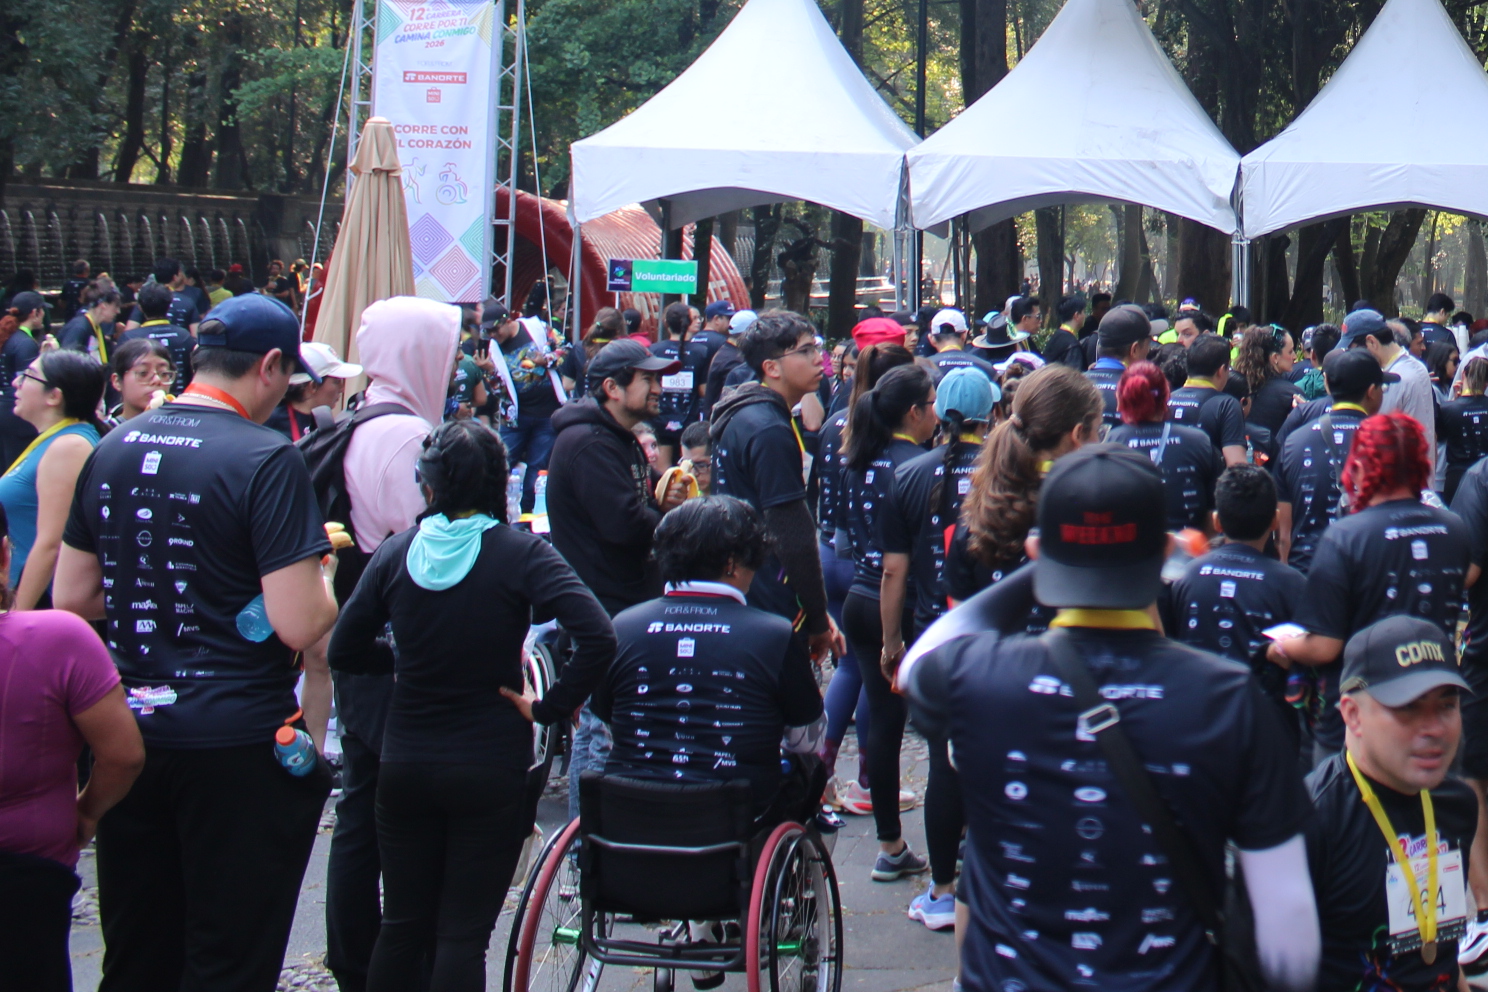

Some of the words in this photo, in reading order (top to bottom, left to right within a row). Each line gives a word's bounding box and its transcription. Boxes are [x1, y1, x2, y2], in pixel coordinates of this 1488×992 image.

[425, 10, 461, 20] CARRERA
[403, 20, 437, 32] CORRE
[437, 18, 457, 29] POR
[459, 17, 468, 26] TI
[394, 31, 431, 44] CAMINA
[432, 26, 476, 39] CONMIGO
[425, 39, 445, 48] 2026
[418, 74, 465, 82] BANORTE
[394, 124, 437, 135] CORRE
[441, 125, 468, 135] CON
[396, 139, 405, 148] L
[408, 138, 471, 149] CORAZÓN
[635, 271, 696, 283] Voluntariado
[669, 378, 686, 387] 983
[138, 433, 204, 448] BANORTE
[1139, 437, 1182, 447] BANTE
[1212, 567, 1265, 581] BANORTE
[664, 606, 718, 616] FOR&FROM
[665, 622, 731, 634] BANORTE
[1395, 639, 1446, 668] CDMX
